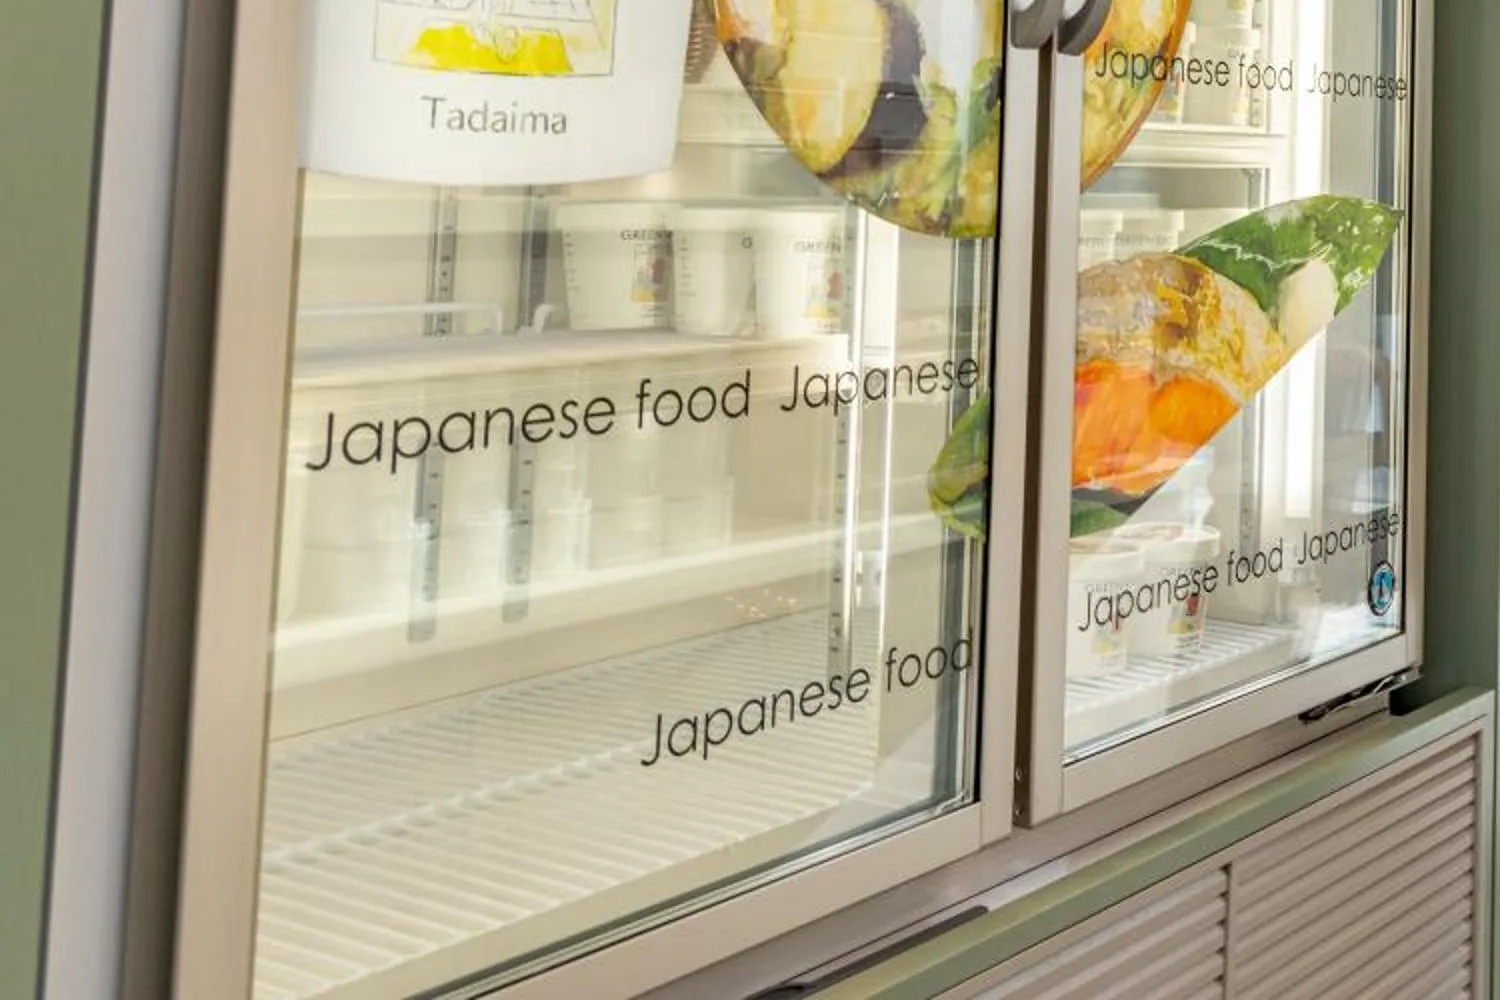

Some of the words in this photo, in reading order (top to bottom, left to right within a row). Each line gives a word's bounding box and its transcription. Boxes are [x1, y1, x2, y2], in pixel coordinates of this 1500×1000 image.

[421, 96, 568, 136] Tadaima
[1095, 42, 1230, 87] Japanese
[1238, 56, 1293, 92] food
[1305, 63, 1408, 102] Japanese
[305, 396, 617, 474] Japanese
[636, 369, 752, 430] food
[780, 355, 979, 412] Japanese
[1078, 563, 1219, 632] Japanese
[1227, 538, 1283, 587] food
[1298, 510, 1400, 566] Japanese
[641, 667, 871, 767] Japanese
[884, 635, 974, 692] food
